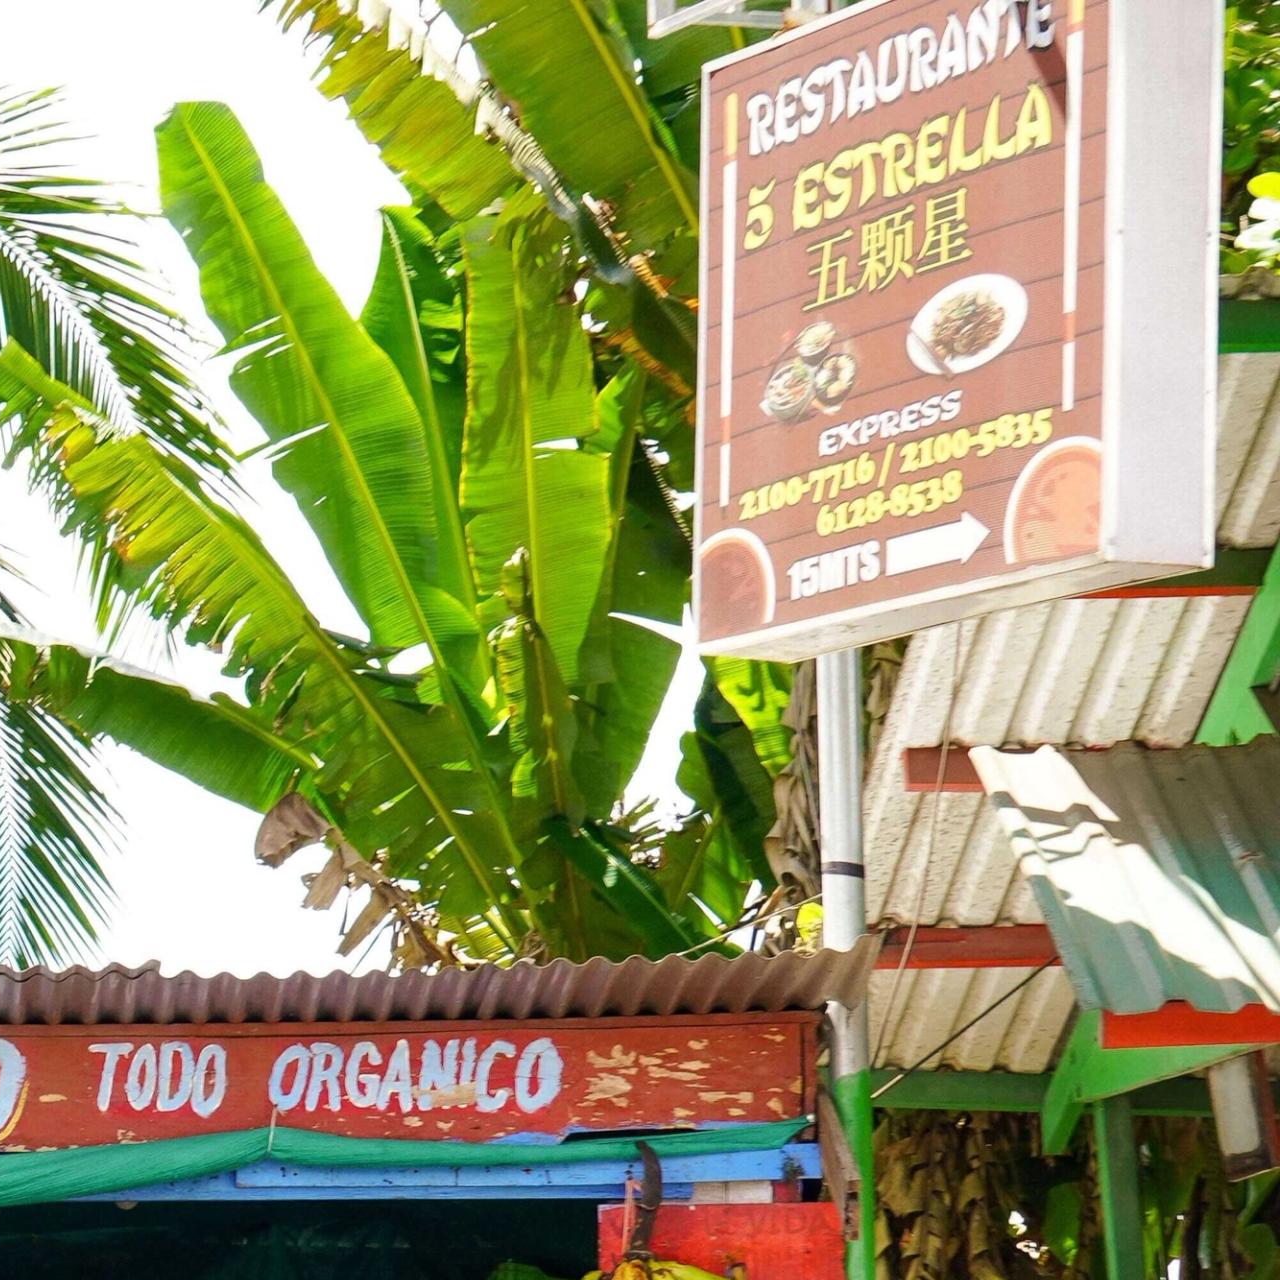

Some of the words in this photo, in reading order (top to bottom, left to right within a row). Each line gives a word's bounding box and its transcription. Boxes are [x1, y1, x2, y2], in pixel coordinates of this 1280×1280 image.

[746, 0, 1055, 156] RESTAURANTE
[743, 177, 776, 250] 5
[791, 83, 1053, 232] ESTRELLA
[801, 187, 973, 312] 五颗星
[738, 451, 876, 521] 2100-7716
[877, 442, 896, 488] /
[898, 407, 1053, 474] 2100-5835
[818, 389, 962, 457] EXPRESS
[815, 469, 963, 537] 6128-8538
[89, 1040, 228, 1118] TODO
[268, 1037, 564, 1113] ORGANICO
